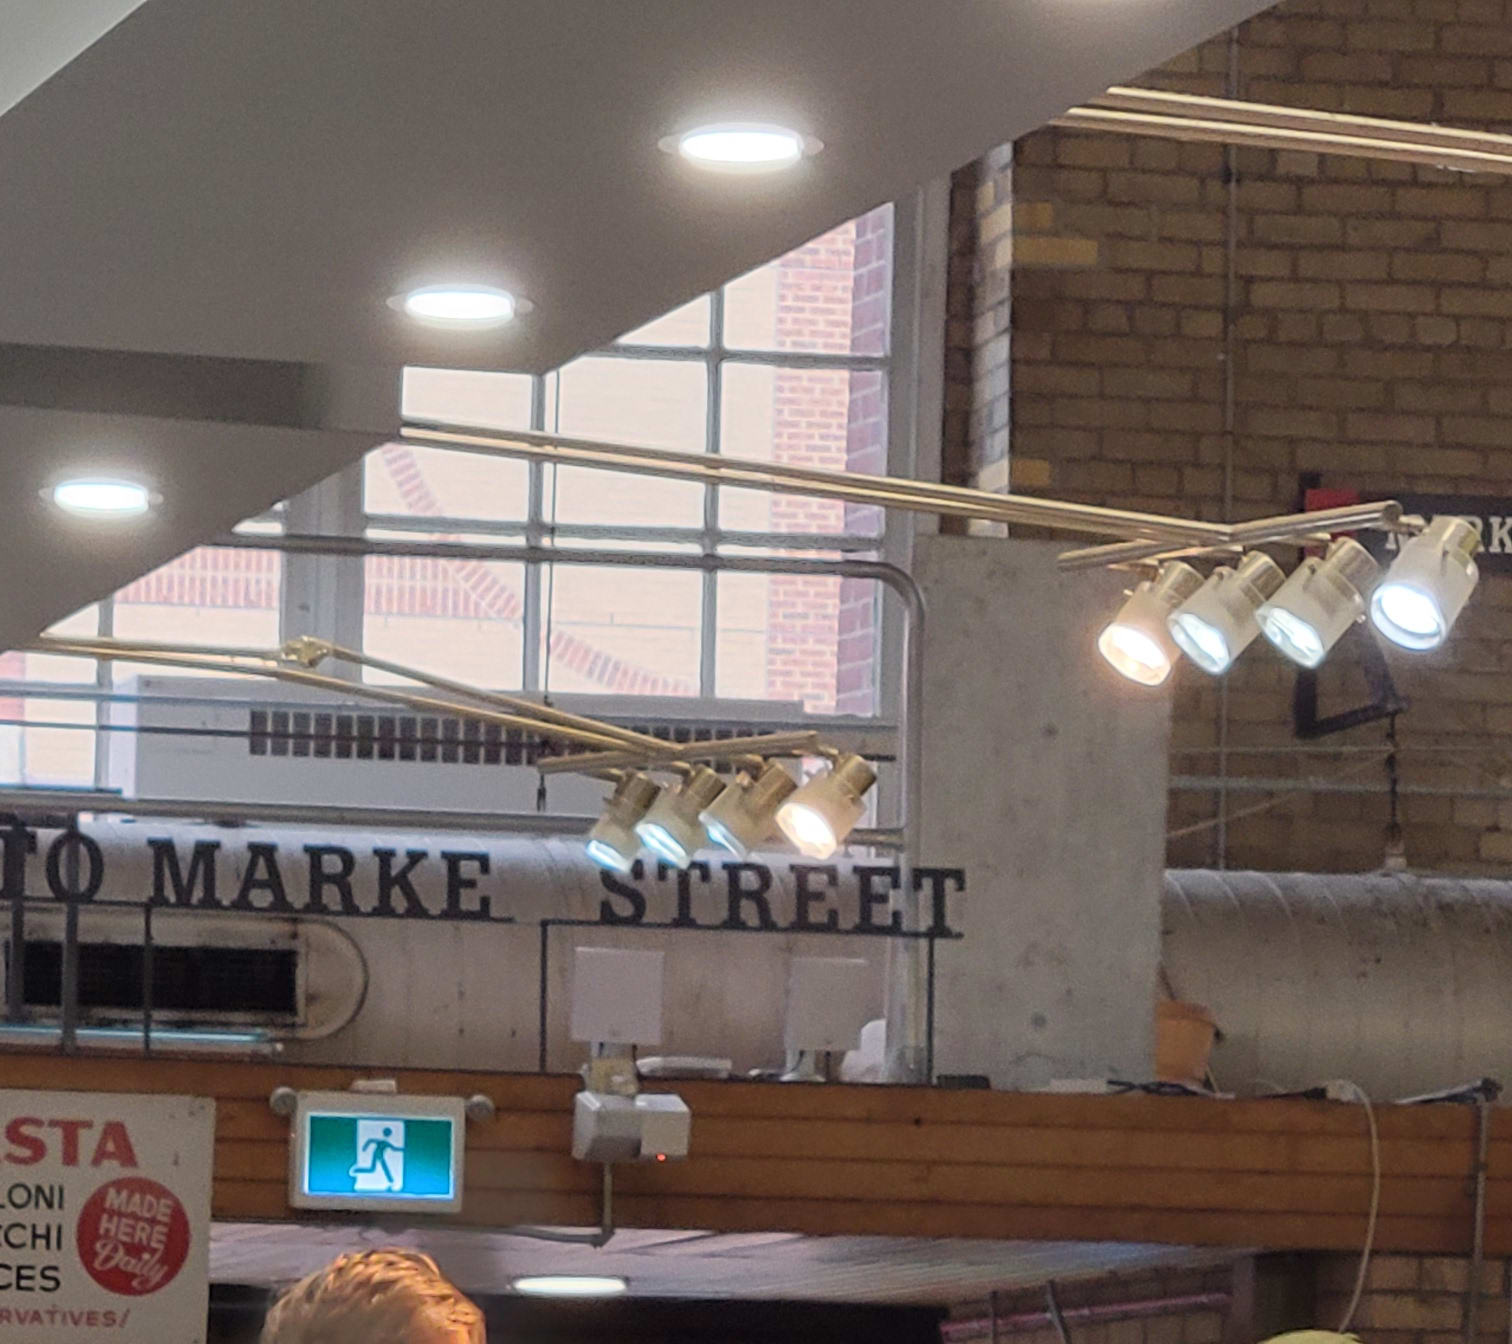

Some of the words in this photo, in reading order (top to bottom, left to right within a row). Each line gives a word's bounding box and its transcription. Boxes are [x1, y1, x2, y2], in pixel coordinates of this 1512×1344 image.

[146, 836, 493, 921] MARKE
[599, 858, 967, 938] STREET
[104, 1187, 174, 1224] MADE
[98, 1214, 170, 1250] HERE
[92, 1239, 170, 1288] Daily
